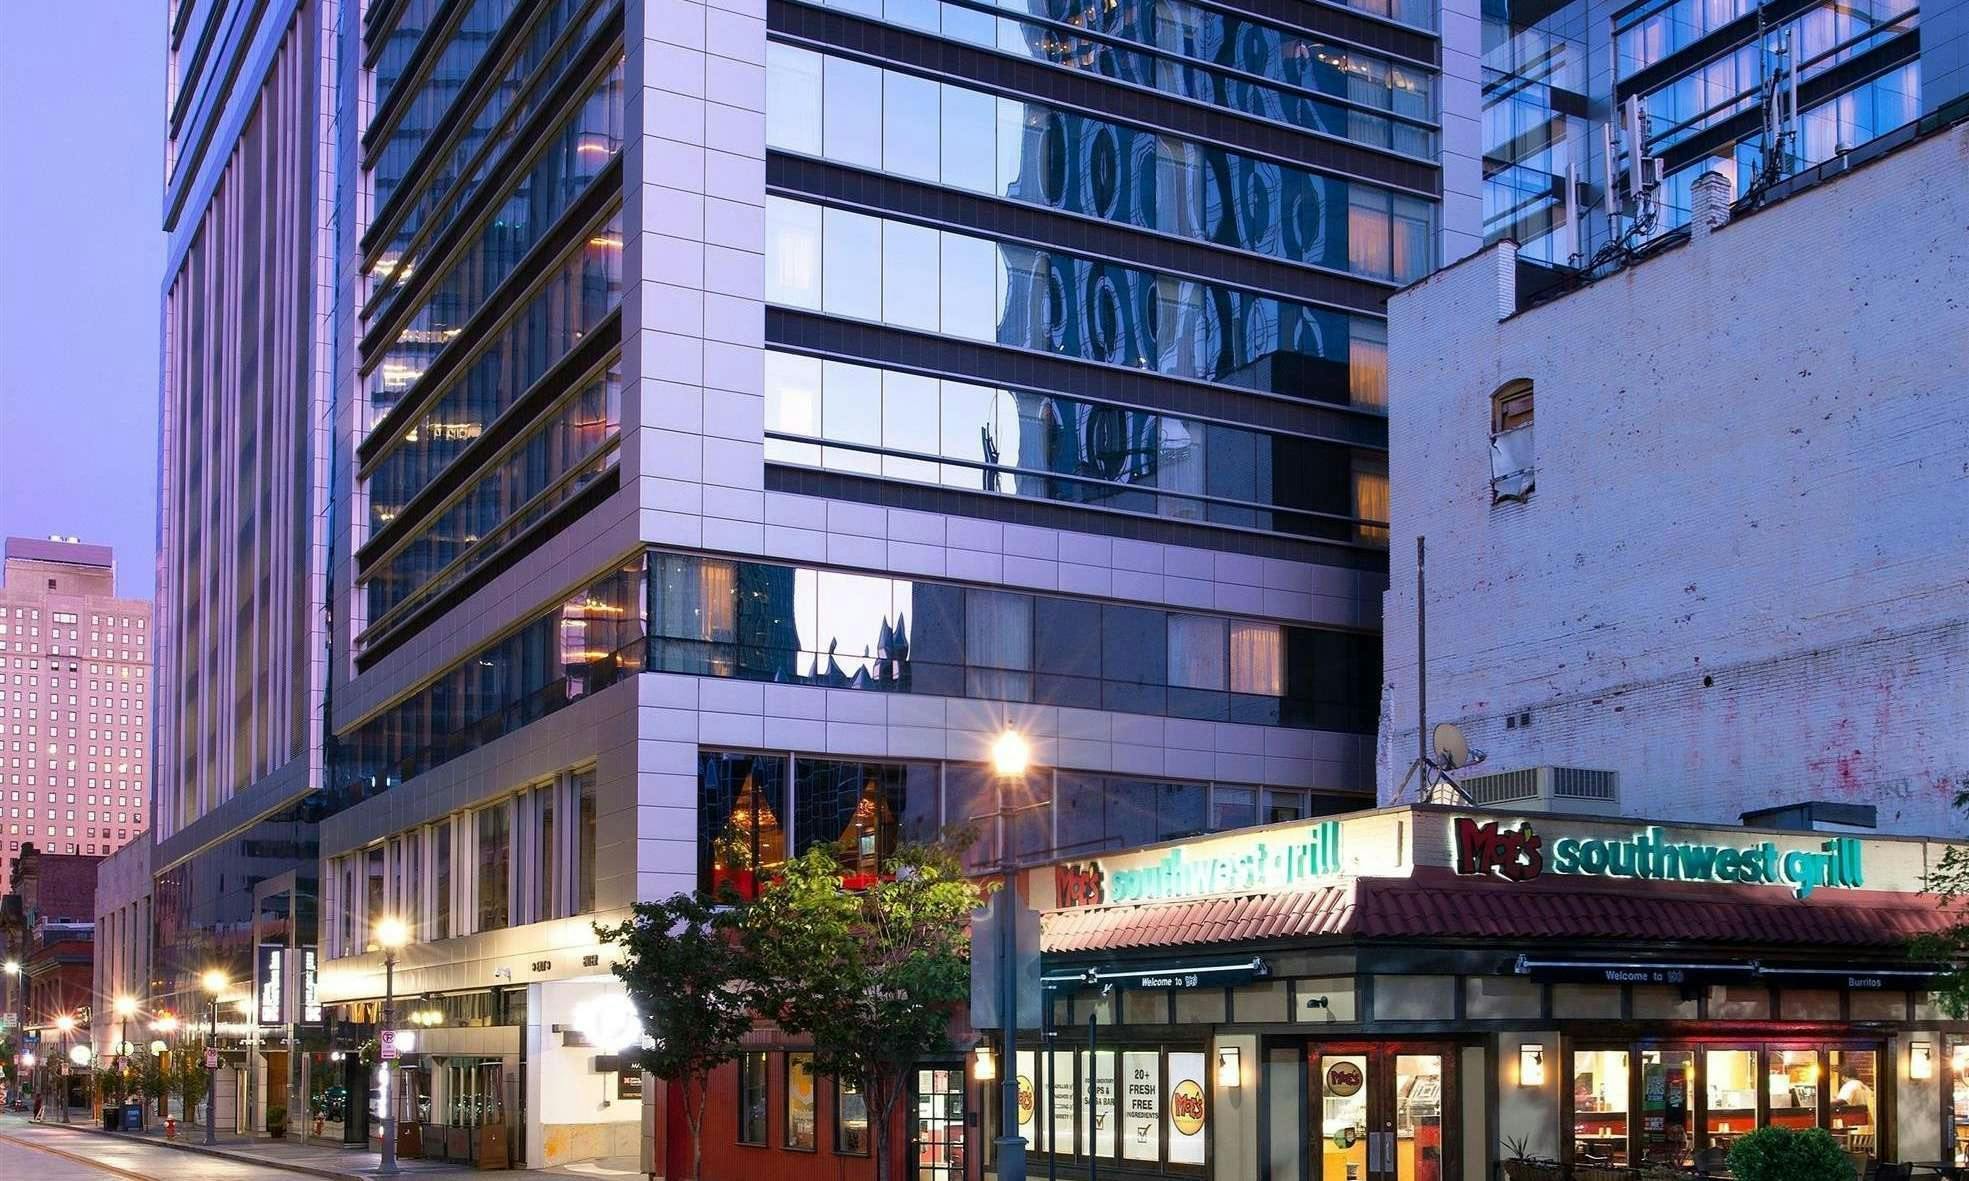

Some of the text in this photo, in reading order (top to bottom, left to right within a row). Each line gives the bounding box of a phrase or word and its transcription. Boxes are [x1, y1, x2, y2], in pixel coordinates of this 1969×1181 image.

[1055, 820, 1341, 909] Moe's southwest grill
[1454, 818, 1864, 900] Moe's southwest grill
[1605, 970, 1648, 981] Welcome
[1653, 971, 1663, 981] to
[1142, 977, 1172, 987] Welcome
[1175, 976, 1182, 986] to
[1848, 976, 1881, 987] Burritos
[1134, 1069, 1150, 1080] 20+
[1129, 1084, 1156, 1095] FRESH
[1132, 1099, 1153, 1110] FREE
[1127, 1111, 1160, 1120] INGREDIENTS
